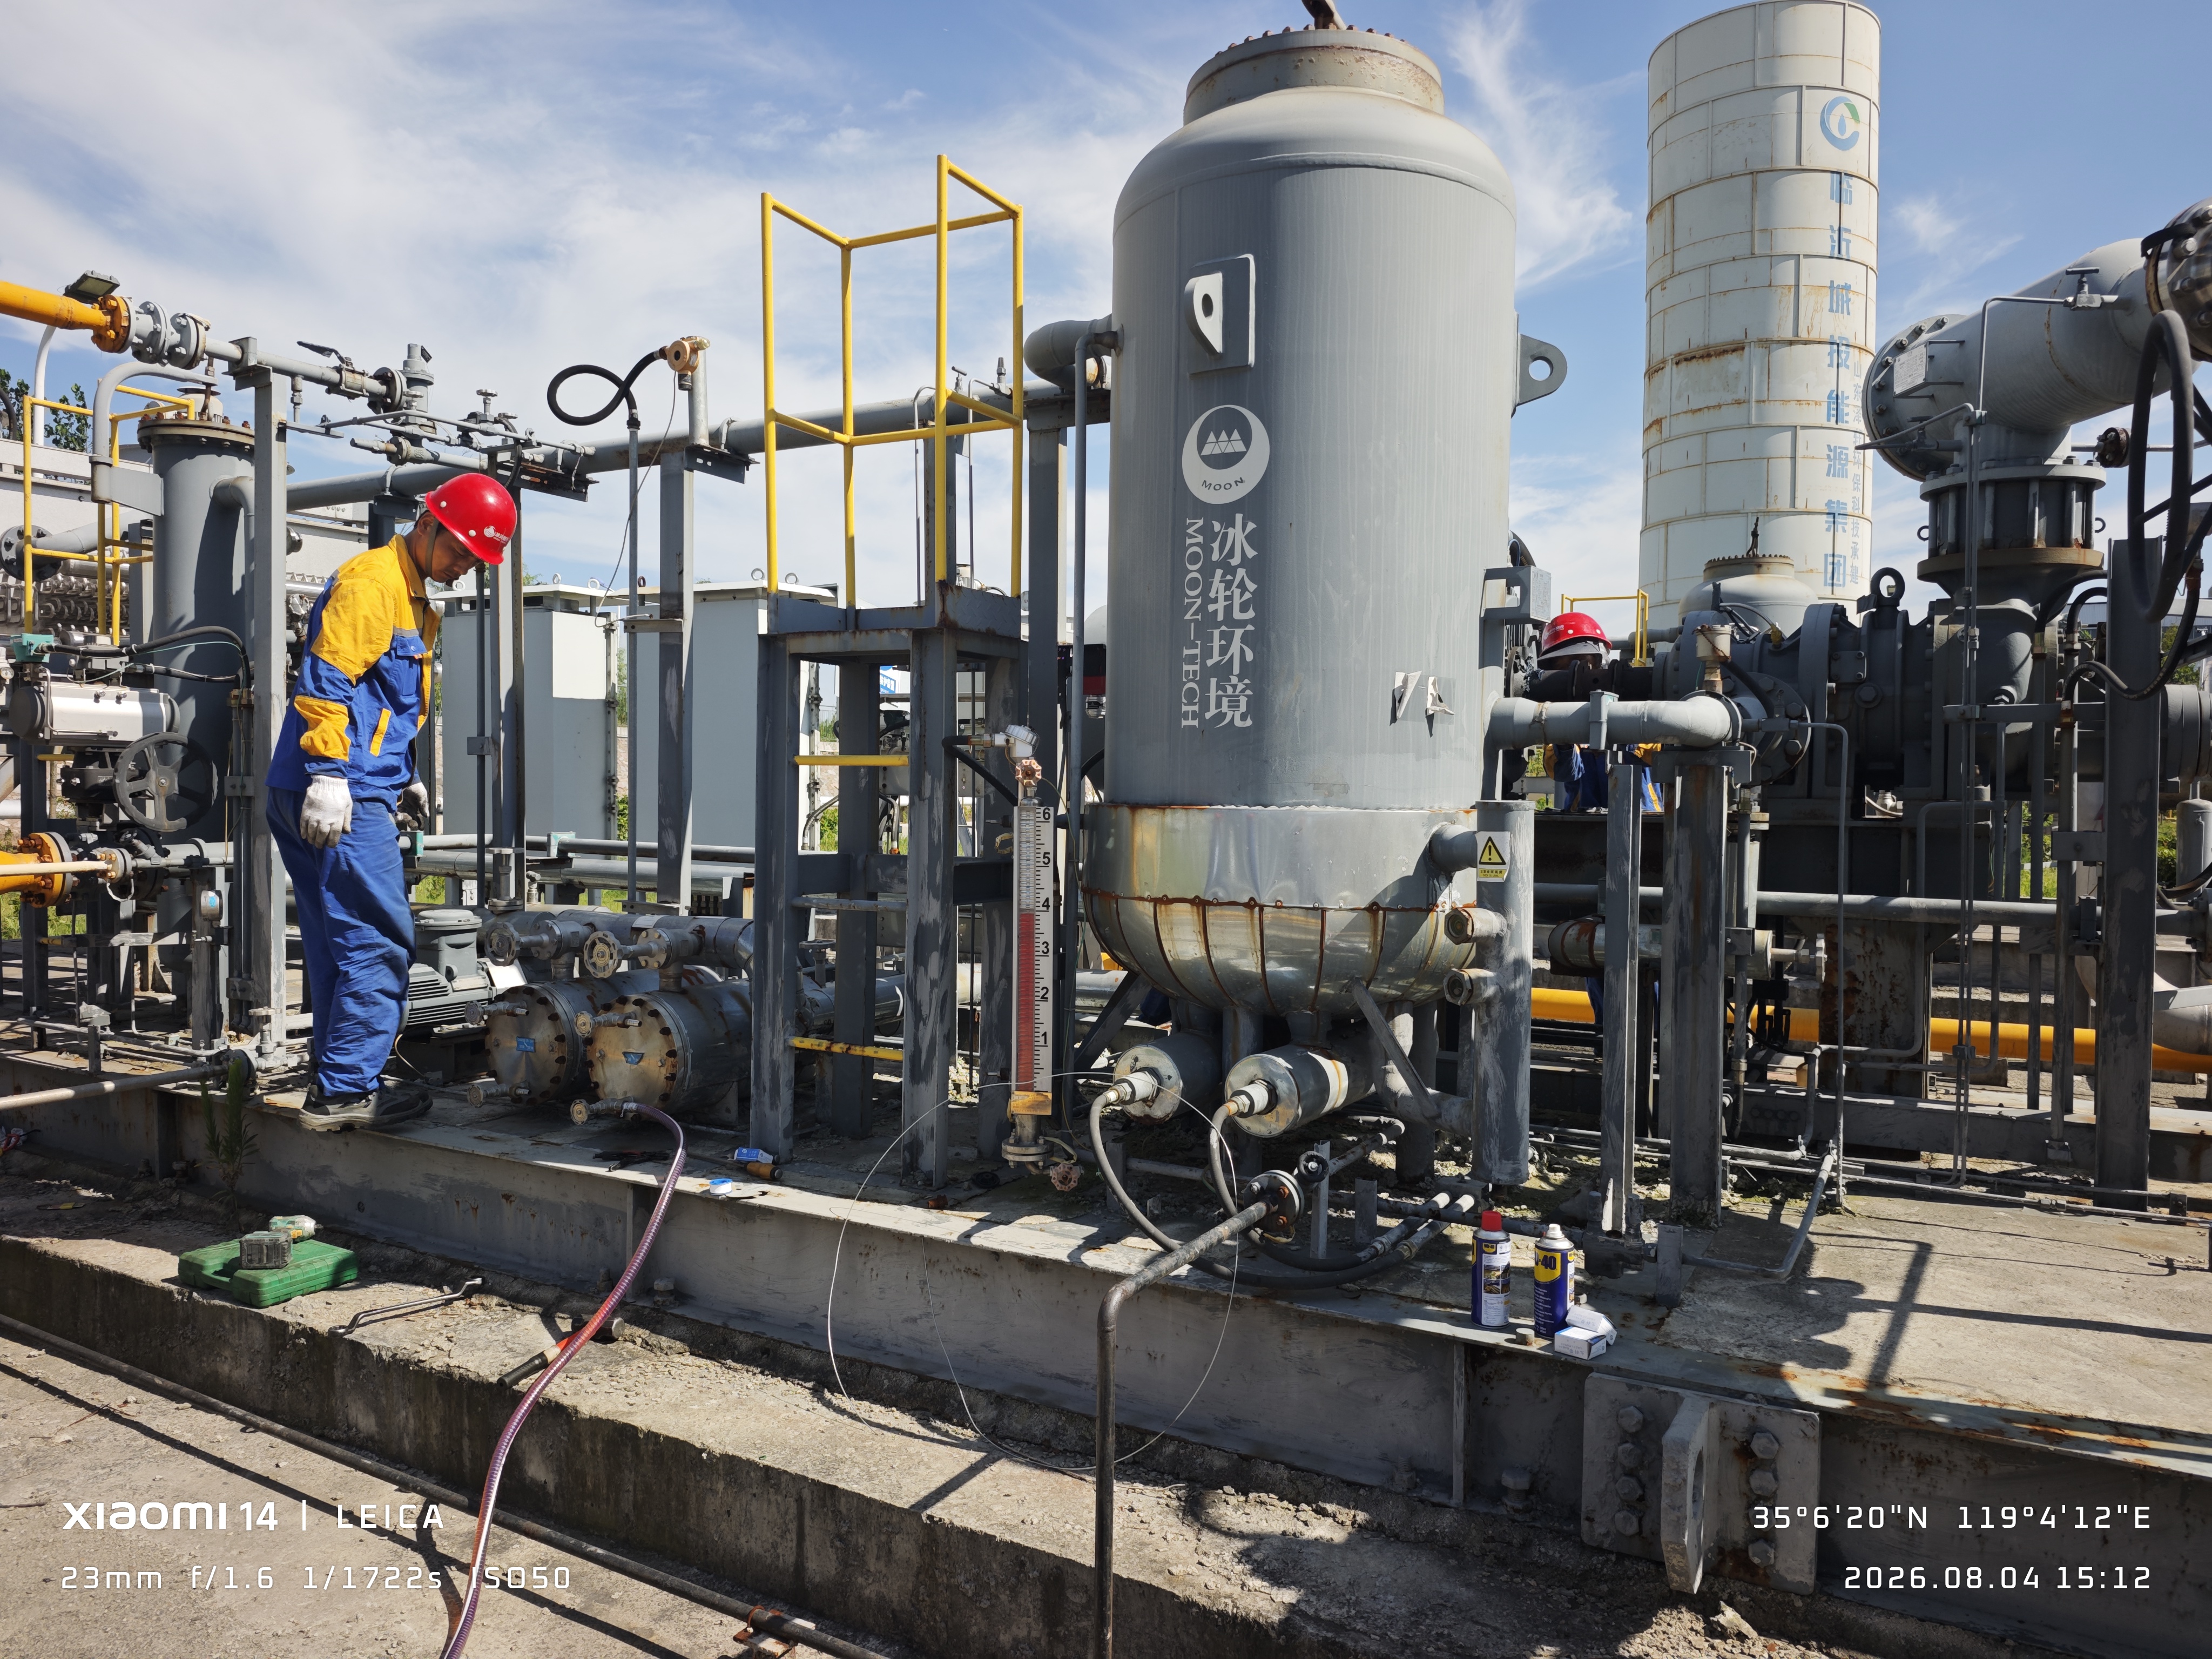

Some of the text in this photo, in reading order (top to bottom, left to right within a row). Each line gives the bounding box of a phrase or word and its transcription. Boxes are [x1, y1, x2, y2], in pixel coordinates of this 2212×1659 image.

[1823, 169, 1853, 588] 临沂城投能源集团
[1202, 477, 1243, 491] MOON
[1181, 517, 1204, 729] MOON-TECH
[1204, 513, 1258, 729] 冰轮环境
[1042, 807, 1051, 820] 6
[1042, 852, 1051, 865] 5
[1042, 897, 1050, 910] 4
[1041, 941, 1049, 954] 3
[1040, 987, 1049, 1000] 2
[1041, 1031, 1047, 1044] 1
